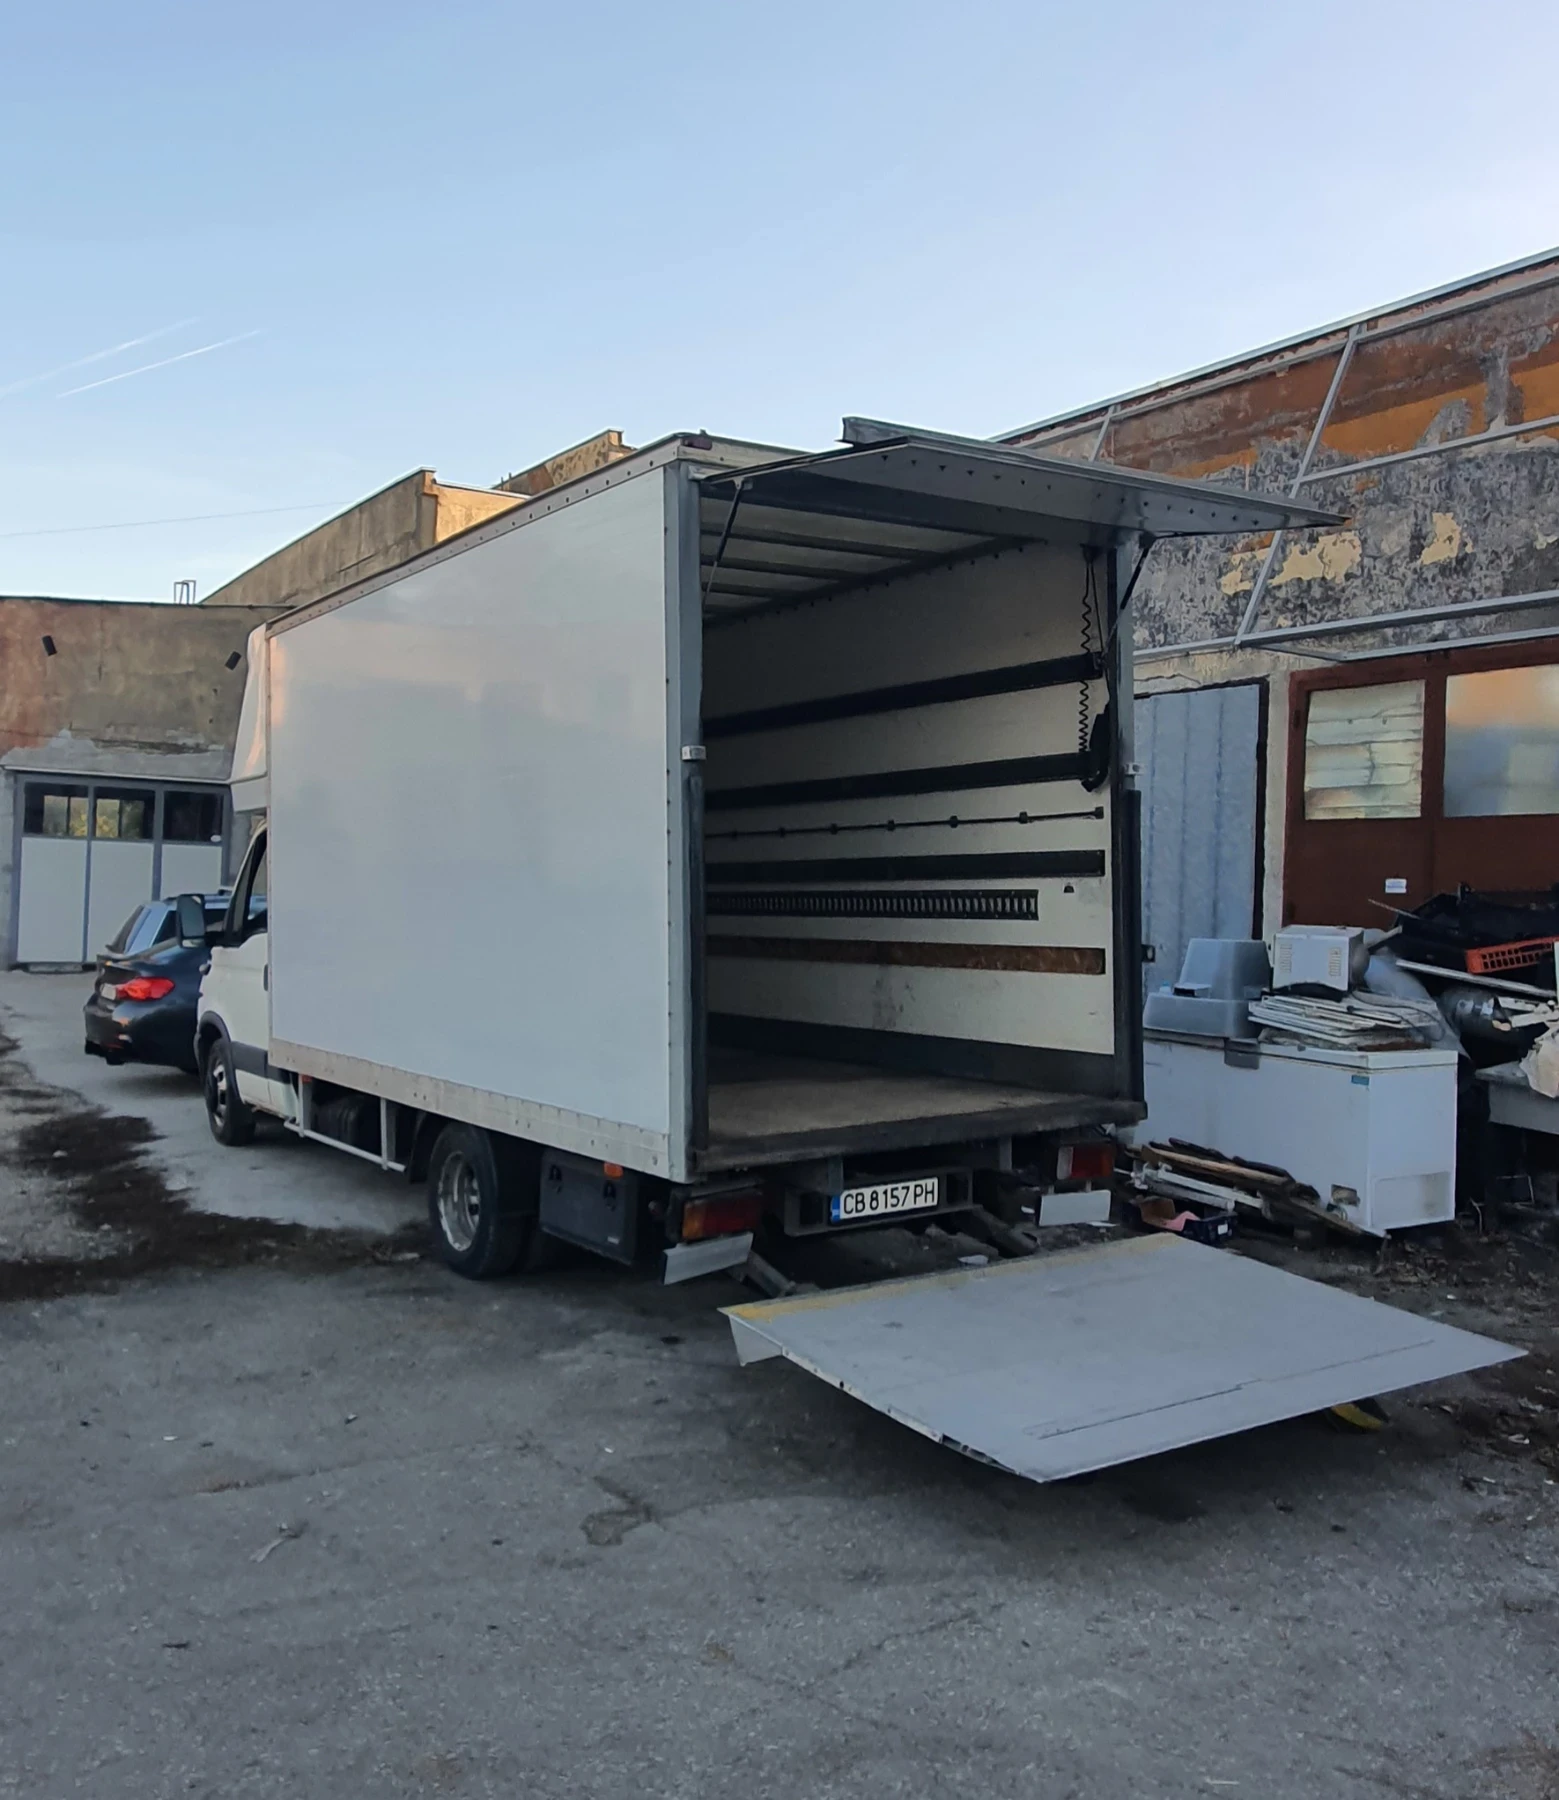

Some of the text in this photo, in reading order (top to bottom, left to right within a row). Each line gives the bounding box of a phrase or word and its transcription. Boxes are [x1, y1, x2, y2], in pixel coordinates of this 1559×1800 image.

[843, 1181, 935, 1214] CB 8157 PH
